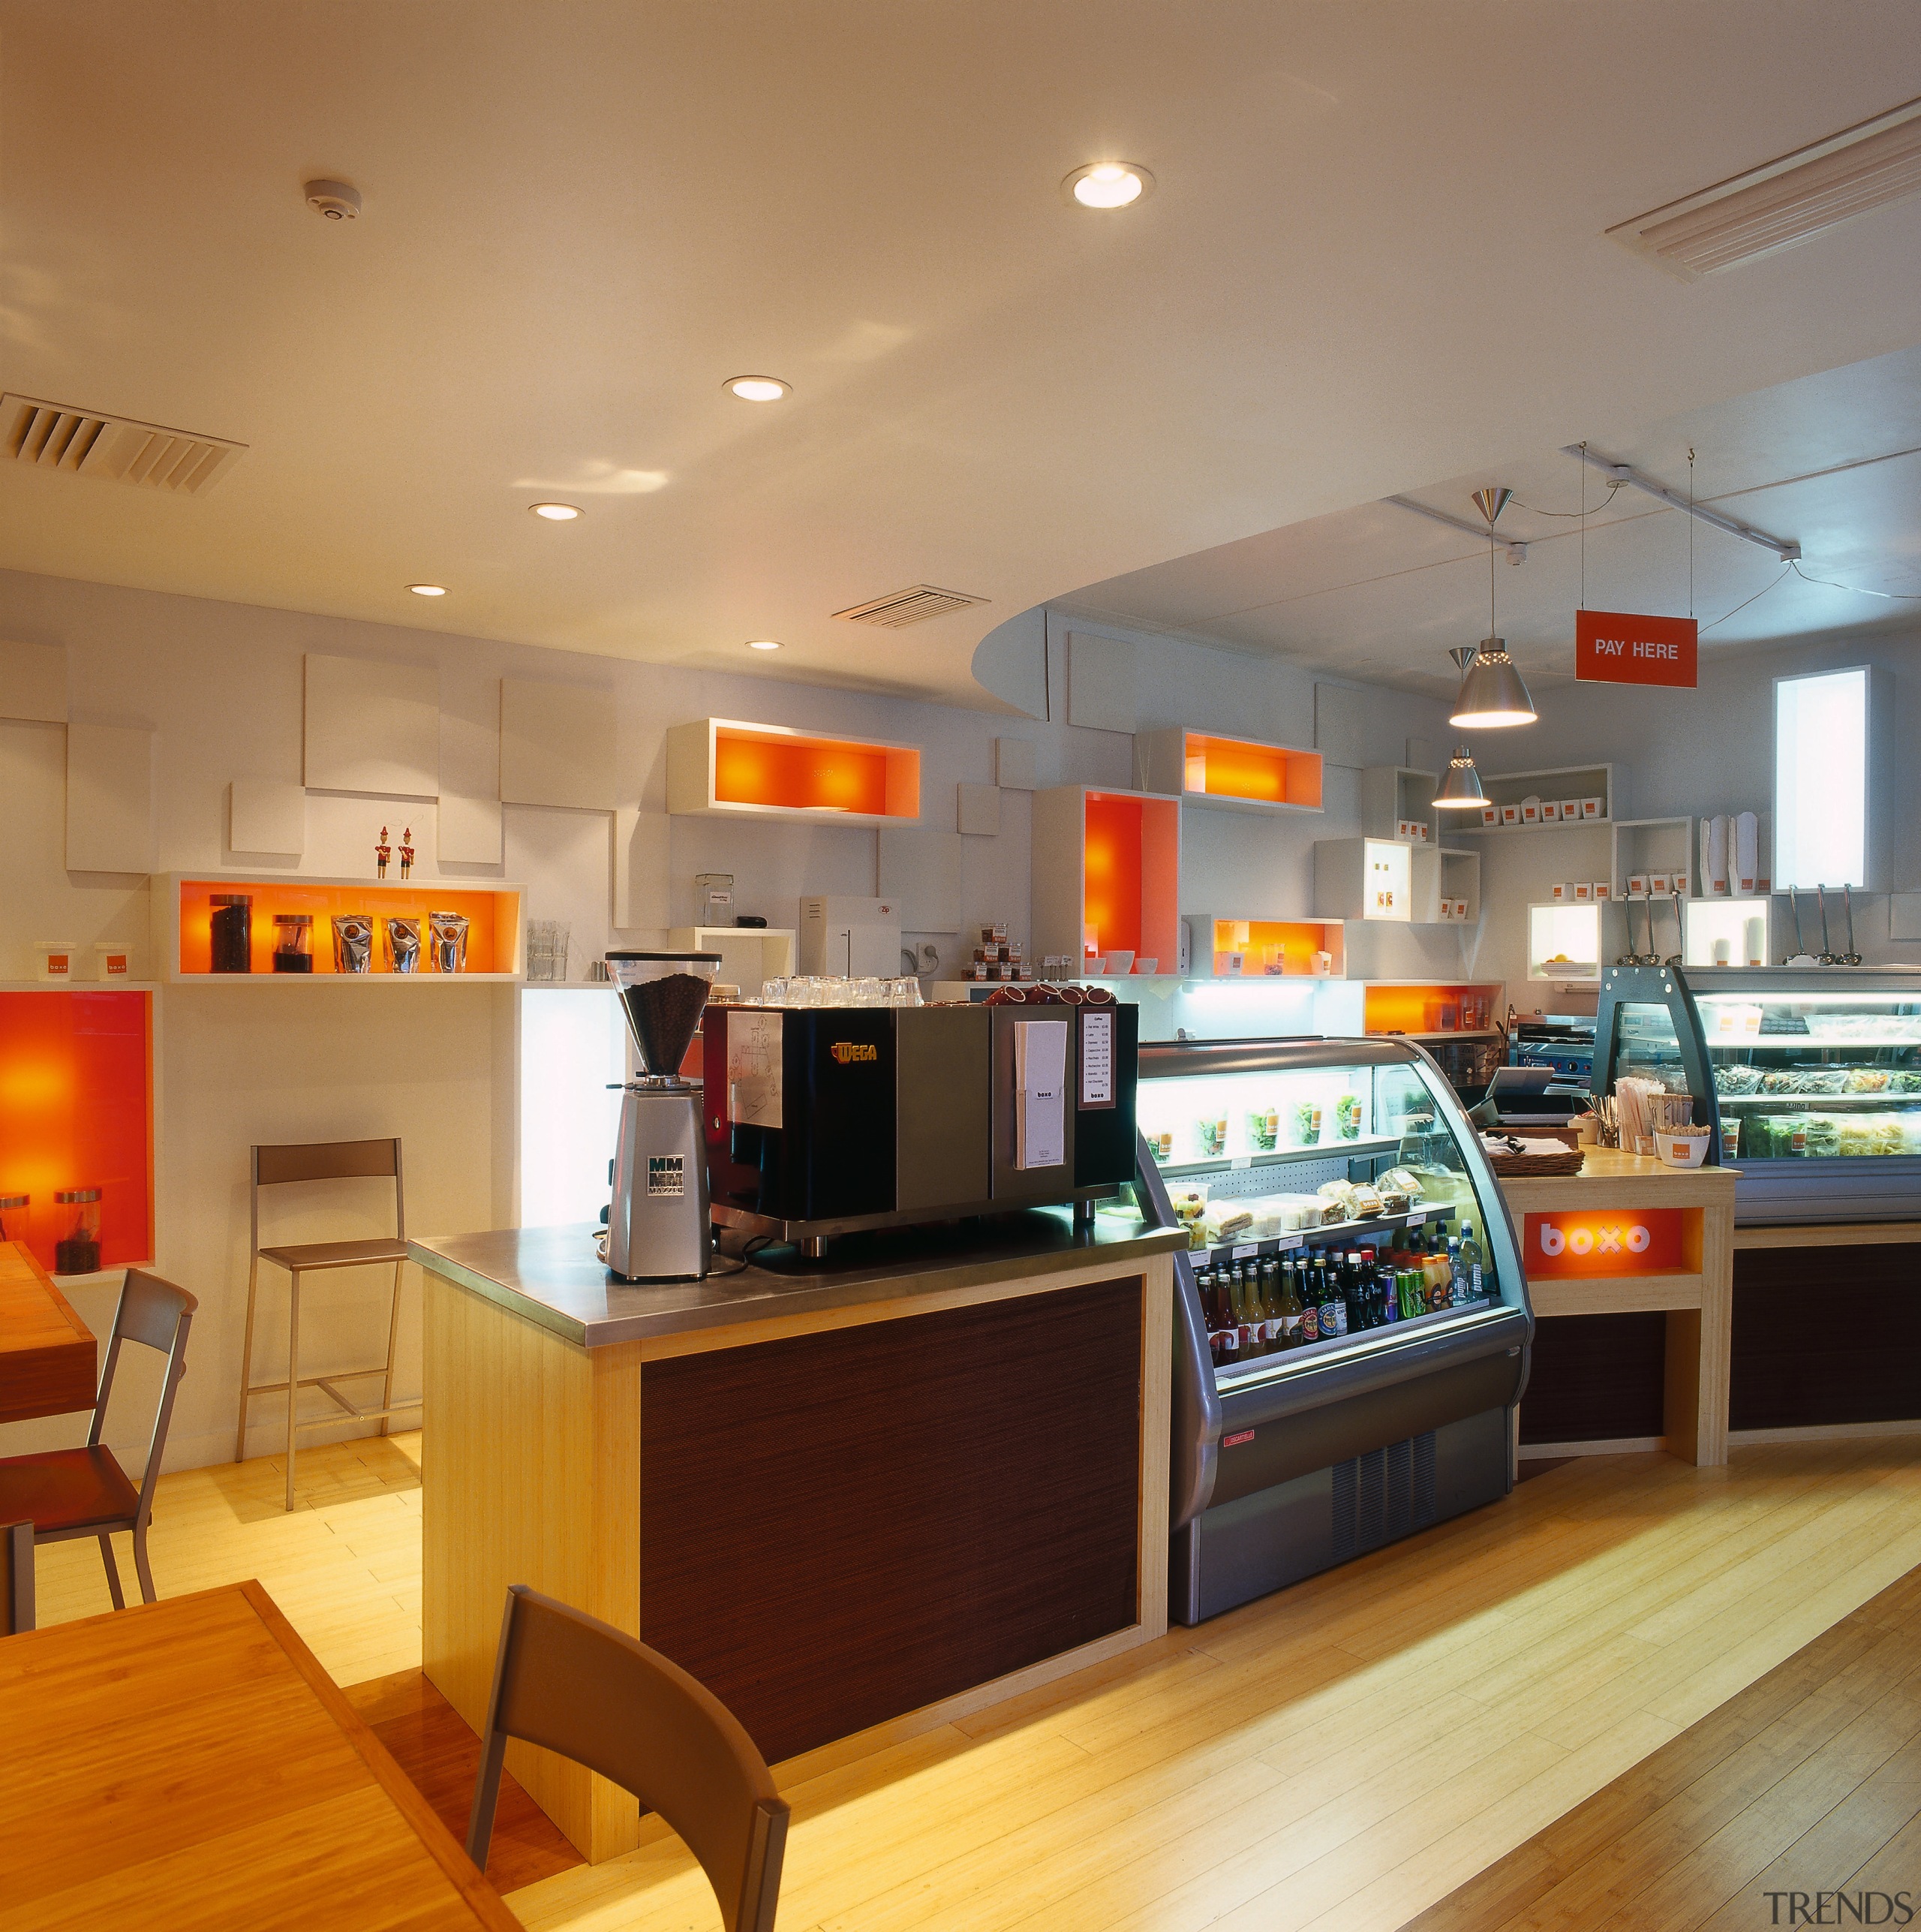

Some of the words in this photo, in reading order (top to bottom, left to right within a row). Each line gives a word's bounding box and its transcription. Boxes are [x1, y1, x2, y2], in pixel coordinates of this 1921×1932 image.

[1595, 639, 1625, 655] PAY
[1633, 642, 1679, 660] HERE
[837, 1043, 877, 1062] WEGA
[1541, 1223, 1651, 1256] boxo
[1457, 1277, 1466, 1299] pump
[1473, 1263, 1483, 1292] pump
